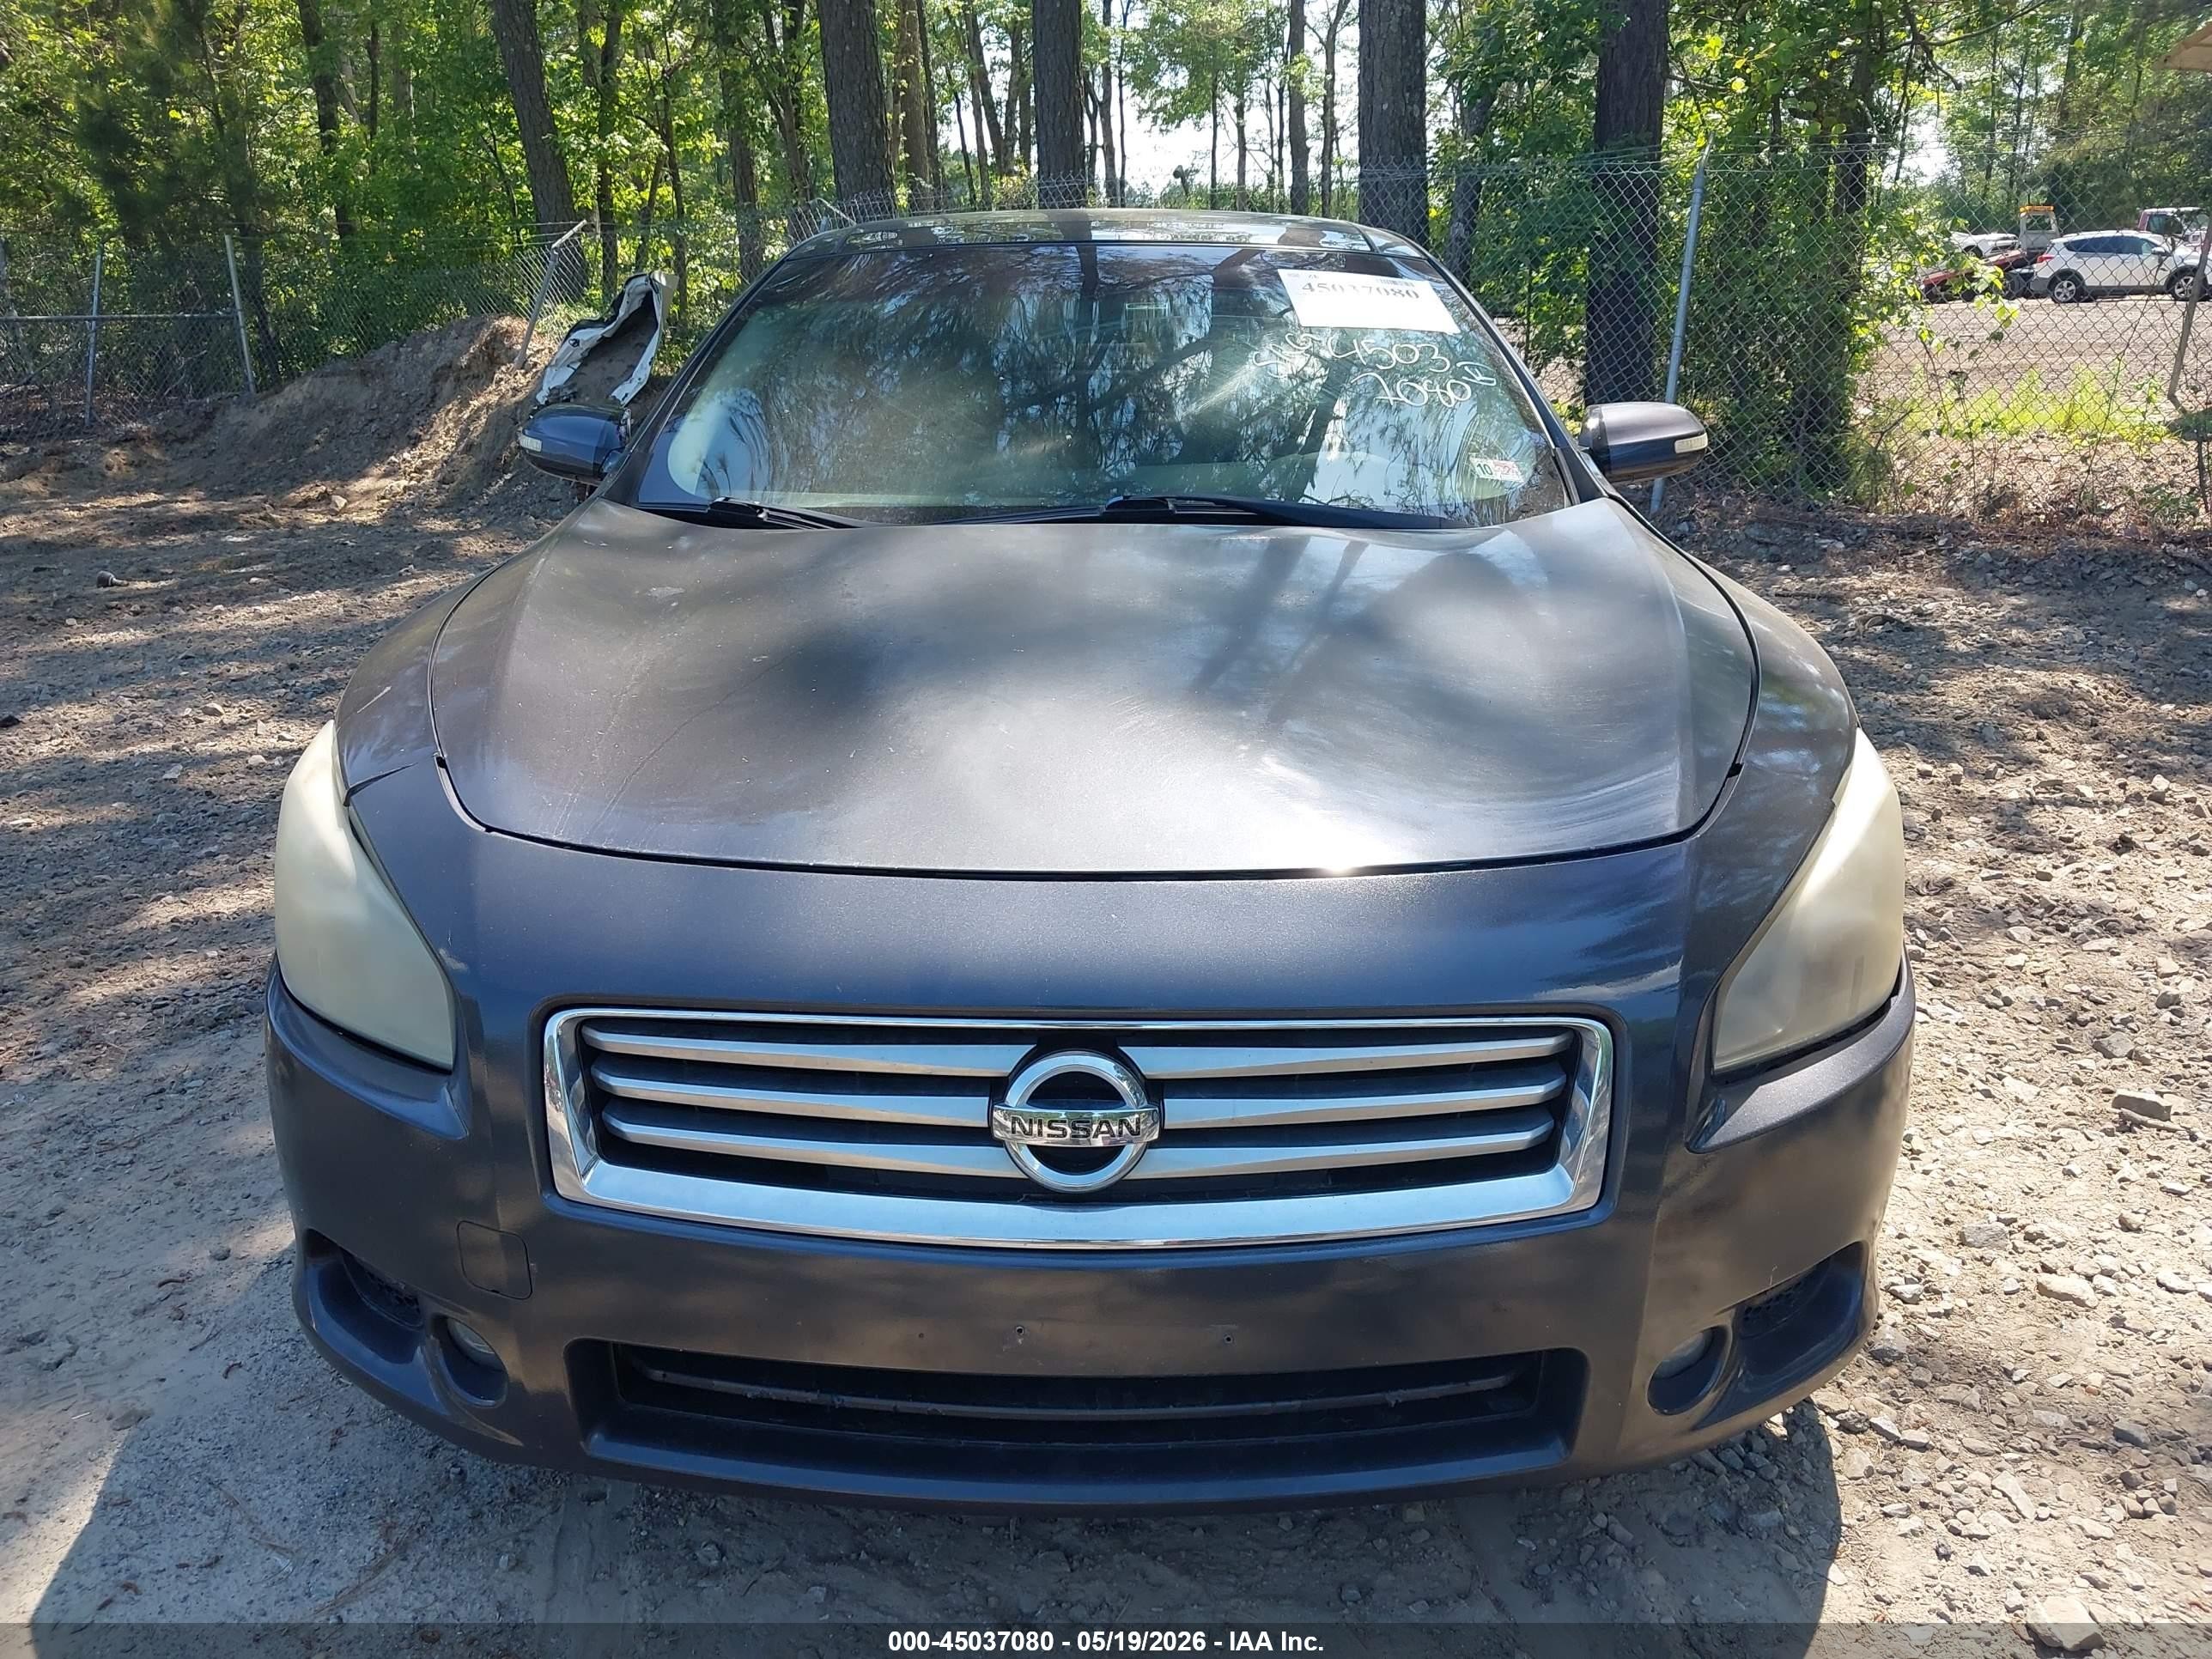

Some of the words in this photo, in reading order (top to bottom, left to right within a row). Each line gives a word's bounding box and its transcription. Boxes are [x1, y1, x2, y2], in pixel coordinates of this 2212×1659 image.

[1302, 282, 1419, 300] 45037080
[1477, 463, 1493, 476] 10
[1011, 1115, 1142, 1139] NISSAN
